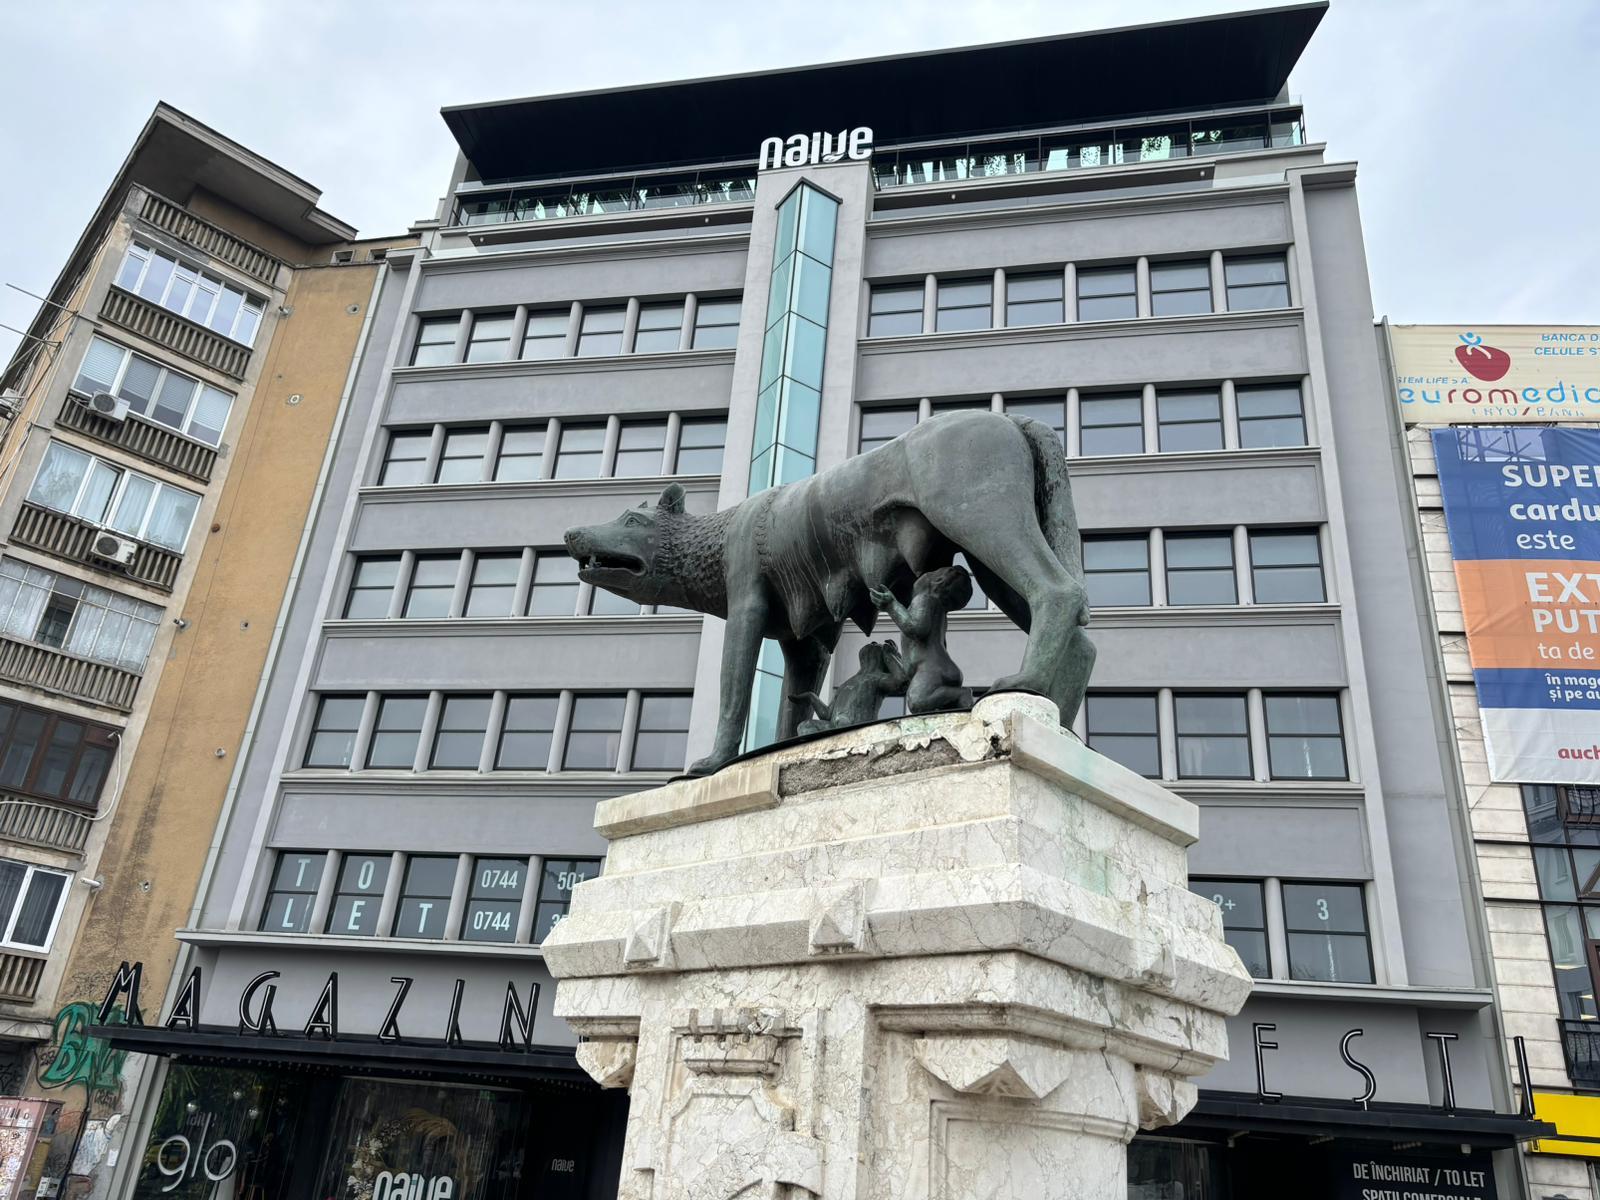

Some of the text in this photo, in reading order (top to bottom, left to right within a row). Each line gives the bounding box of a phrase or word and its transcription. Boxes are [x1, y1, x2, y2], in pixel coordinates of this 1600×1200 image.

[1541, 333, 1586, 342] BANCA
[1534, 346, 1600, 356] CELULE S
[1426, 376, 1448, 385] LIFE
[1509, 497, 1600, 522] cardu
[1516, 529, 1576, 550] este
[1532, 608, 1600, 634] PUT
[1537, 641, 1595, 660] ta de
[1544, 672, 1561, 686] în
[1549, 686, 1562, 703] și
[1564, 689, 1583, 703] pe
[1557, 745, 1600, 760] auch
[481, 870, 519, 889] 0744
[1316, 898, 1330, 921] 3
[473, 910, 512, 931] 0744
[97, 960, 592, 1050] MAGAZIN
[1352, 1162, 1370, 1180] DE
[1370, 1160, 1430, 1184] ÎNCHIRIAT
[1443, 1169, 1461, 1186] TO
[1463, 1171, 1486, 1188] LET
